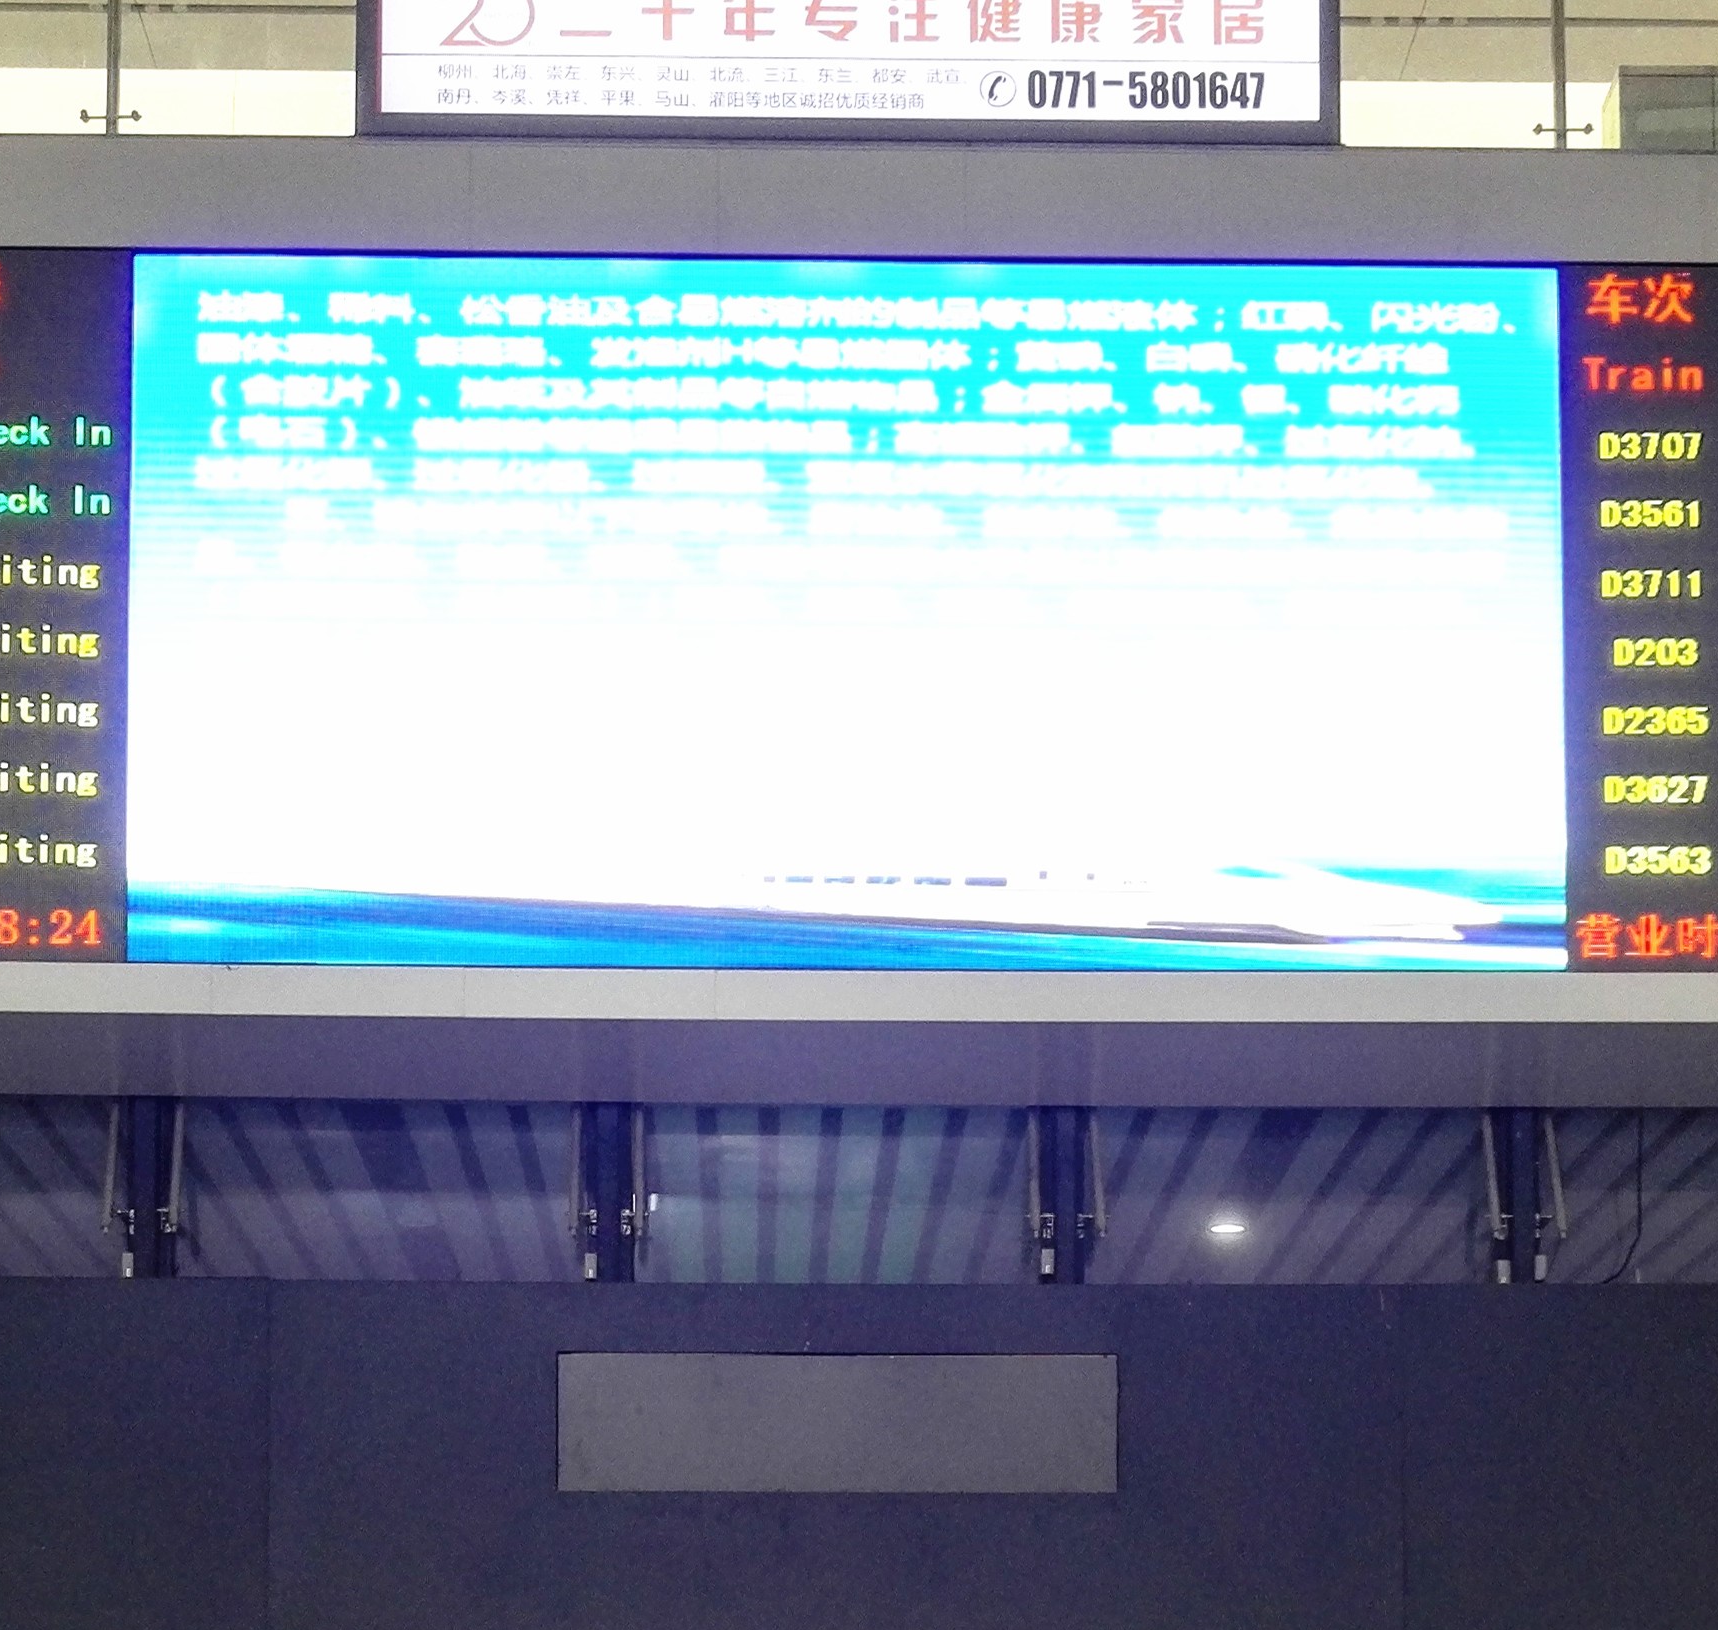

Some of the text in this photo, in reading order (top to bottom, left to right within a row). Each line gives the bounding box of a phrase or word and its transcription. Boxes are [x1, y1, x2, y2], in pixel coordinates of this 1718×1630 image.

[1028, 69, 1266, 109] 0771-5801647
[1587, 274, 1695, 326] 车次
[1584, 357, 1704, 393] Train
[76, 417, 112, 447] In
[1600, 433, 1703, 461] D3707
[75, 485, 112, 516] In
[1601, 500, 1701, 529] D3561
[1602, 570, 1702, 599] D3711
[1614, 638, 1700, 668] D203
[1603, 707, 1710, 736] D2365
[1604, 776, 1710, 805] D3627
[1605, 846, 1713, 876] D3563
